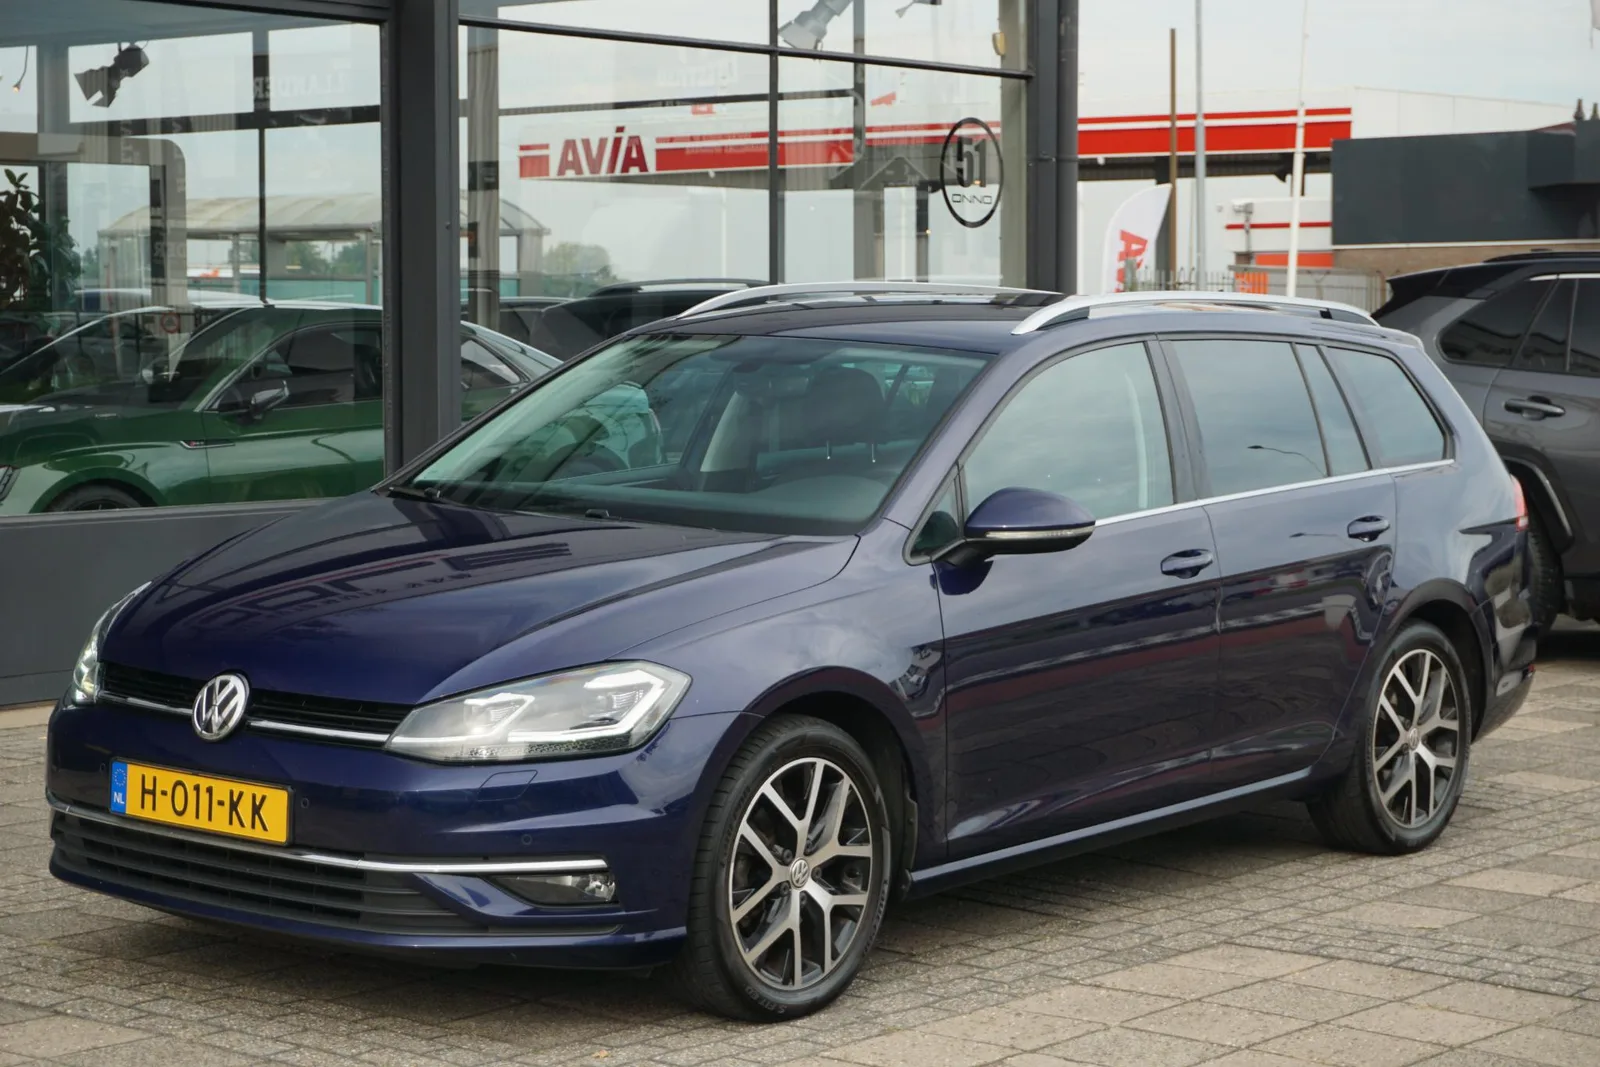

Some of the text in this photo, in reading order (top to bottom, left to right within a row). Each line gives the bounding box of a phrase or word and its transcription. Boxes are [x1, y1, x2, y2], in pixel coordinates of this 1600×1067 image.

[956, 136, 986, 188] 51
[113, 791, 125, 804] NL
[140, 773, 269, 832] H-011-KK
